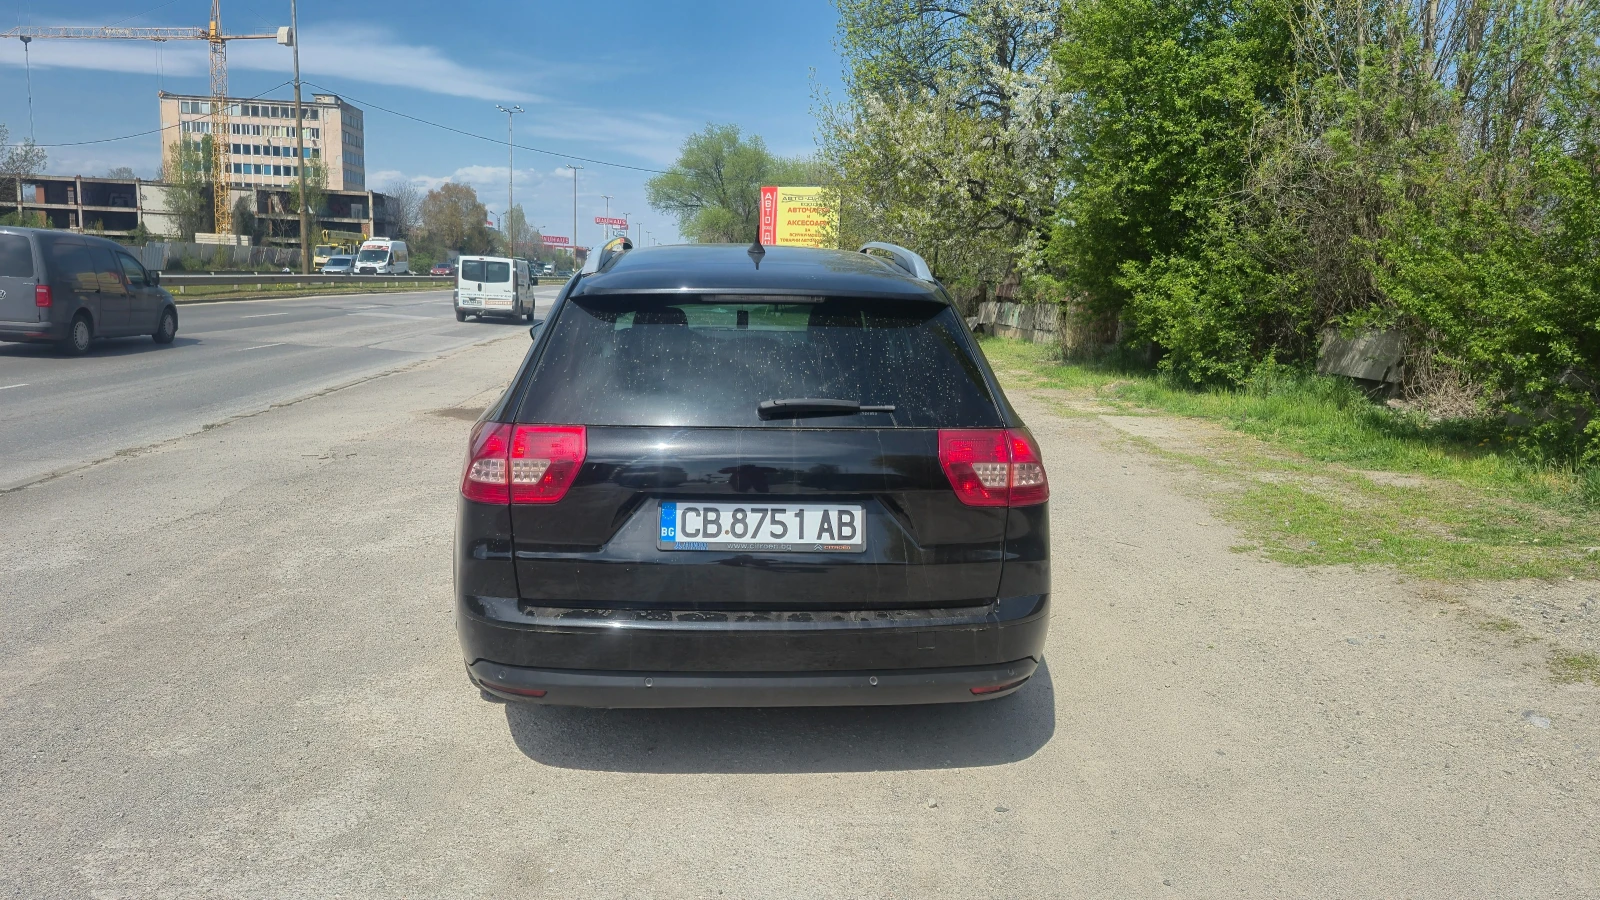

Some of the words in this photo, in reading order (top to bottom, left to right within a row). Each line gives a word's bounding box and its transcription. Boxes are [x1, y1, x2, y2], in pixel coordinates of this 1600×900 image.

[680, 507, 722, 539] CB
[729, 507, 805, 540] 8751
[816, 509, 857, 541] AB
[661, 527, 675, 537] BG
[726, 543, 792, 551] www.citroen.bg
